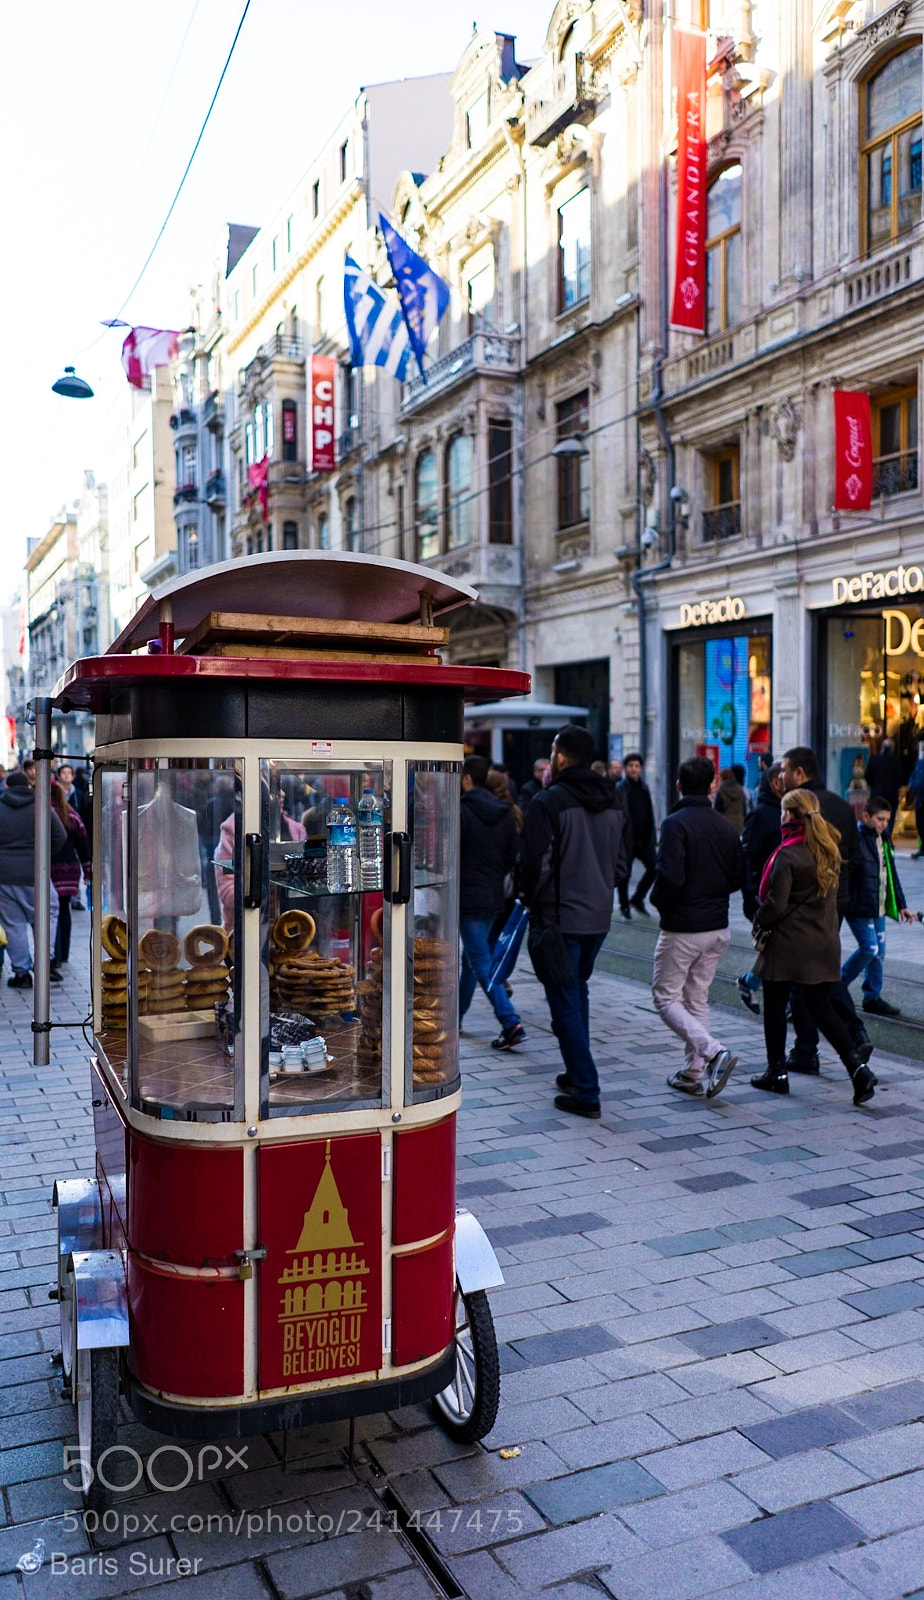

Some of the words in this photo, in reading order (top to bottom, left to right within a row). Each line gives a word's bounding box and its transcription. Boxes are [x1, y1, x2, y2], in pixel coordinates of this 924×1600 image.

[685, 91, 700, 267] GRANDPERA
[314, 380, 333, 450] CHP
[680, 597, 745, 627] DeFacto
[283, 1312, 361, 1352] BEYOĞLU
